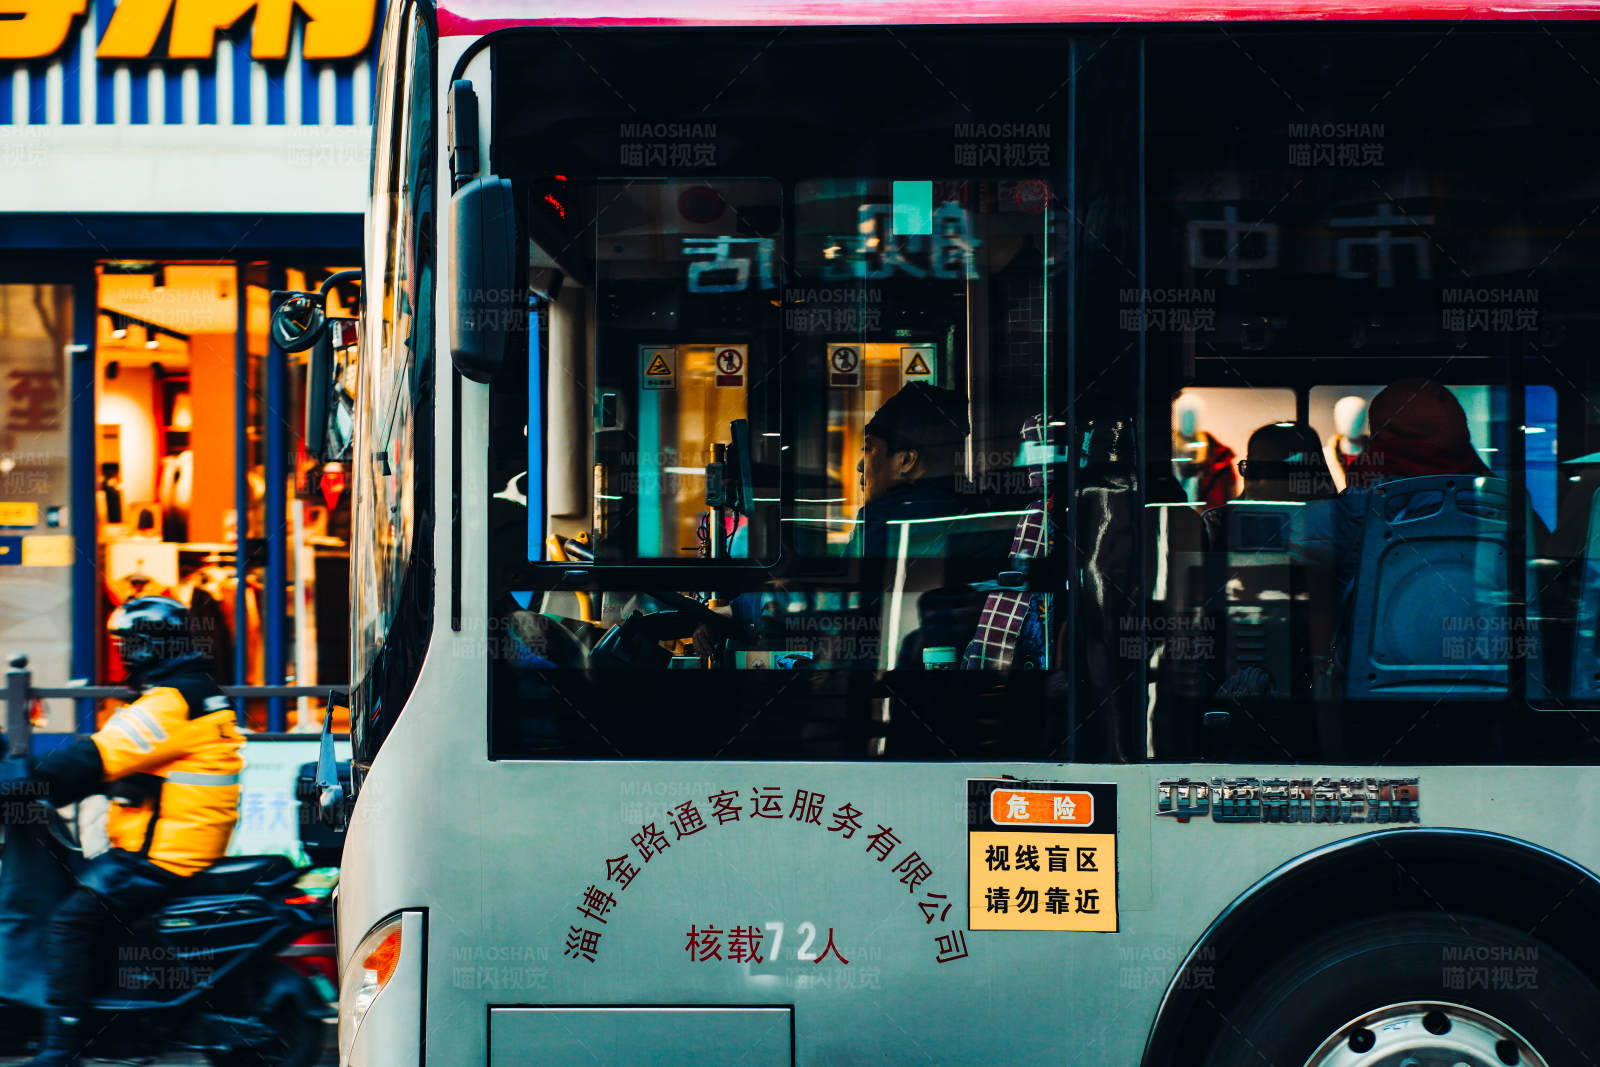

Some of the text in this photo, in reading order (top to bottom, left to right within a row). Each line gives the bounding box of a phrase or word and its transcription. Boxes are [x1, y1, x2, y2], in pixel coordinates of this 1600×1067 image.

[1006, 794, 1077, 821] 危险
[985, 844, 1099, 873] 视线盲区
[564, 786, 969, 964] 淄博金路通客运服务有限公司
[985, 886, 1101, 915] 请勿靠近
[685, 921, 850, 965] 核载72人
